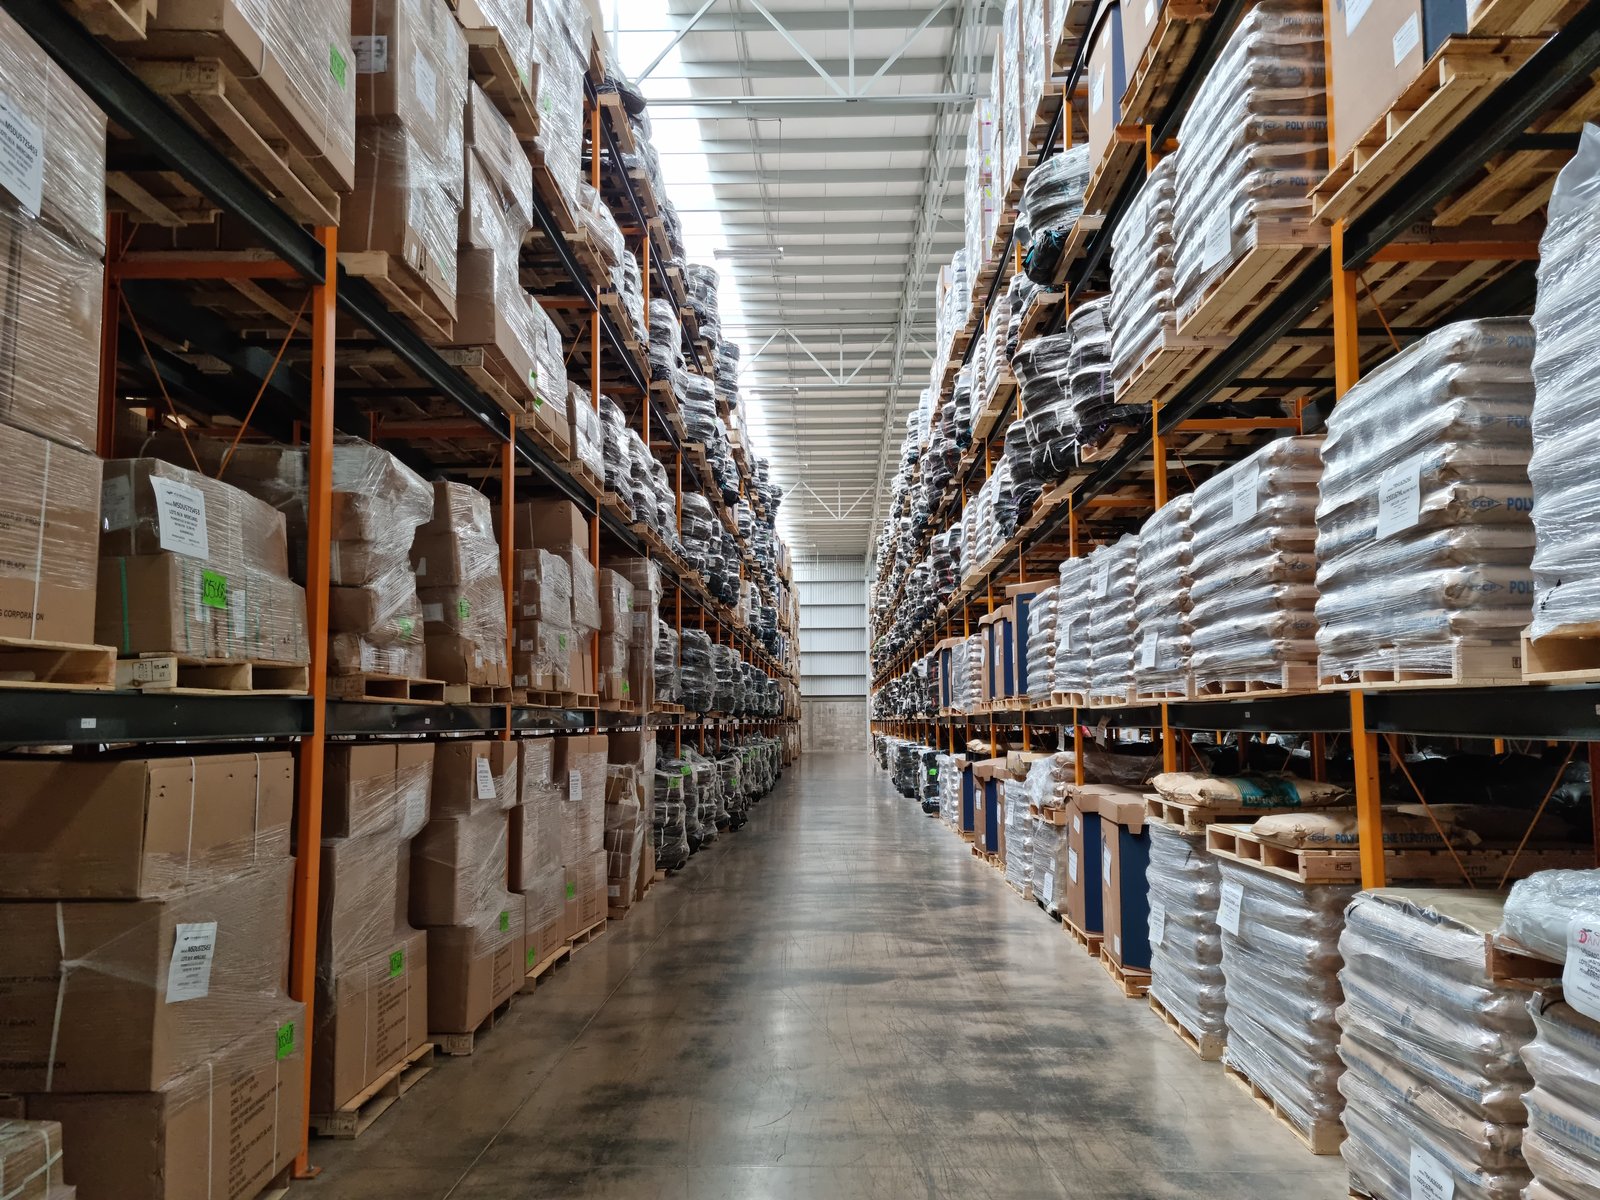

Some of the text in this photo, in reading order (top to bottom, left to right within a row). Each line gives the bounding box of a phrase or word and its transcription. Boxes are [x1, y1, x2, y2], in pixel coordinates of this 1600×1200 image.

[1285, 120, 1305, 131] POLY
[1471, 499, 1495, 509] CCP
[3, 608, 45, 622] CORPORAON
[1335, 832, 1356, 844] POLY
